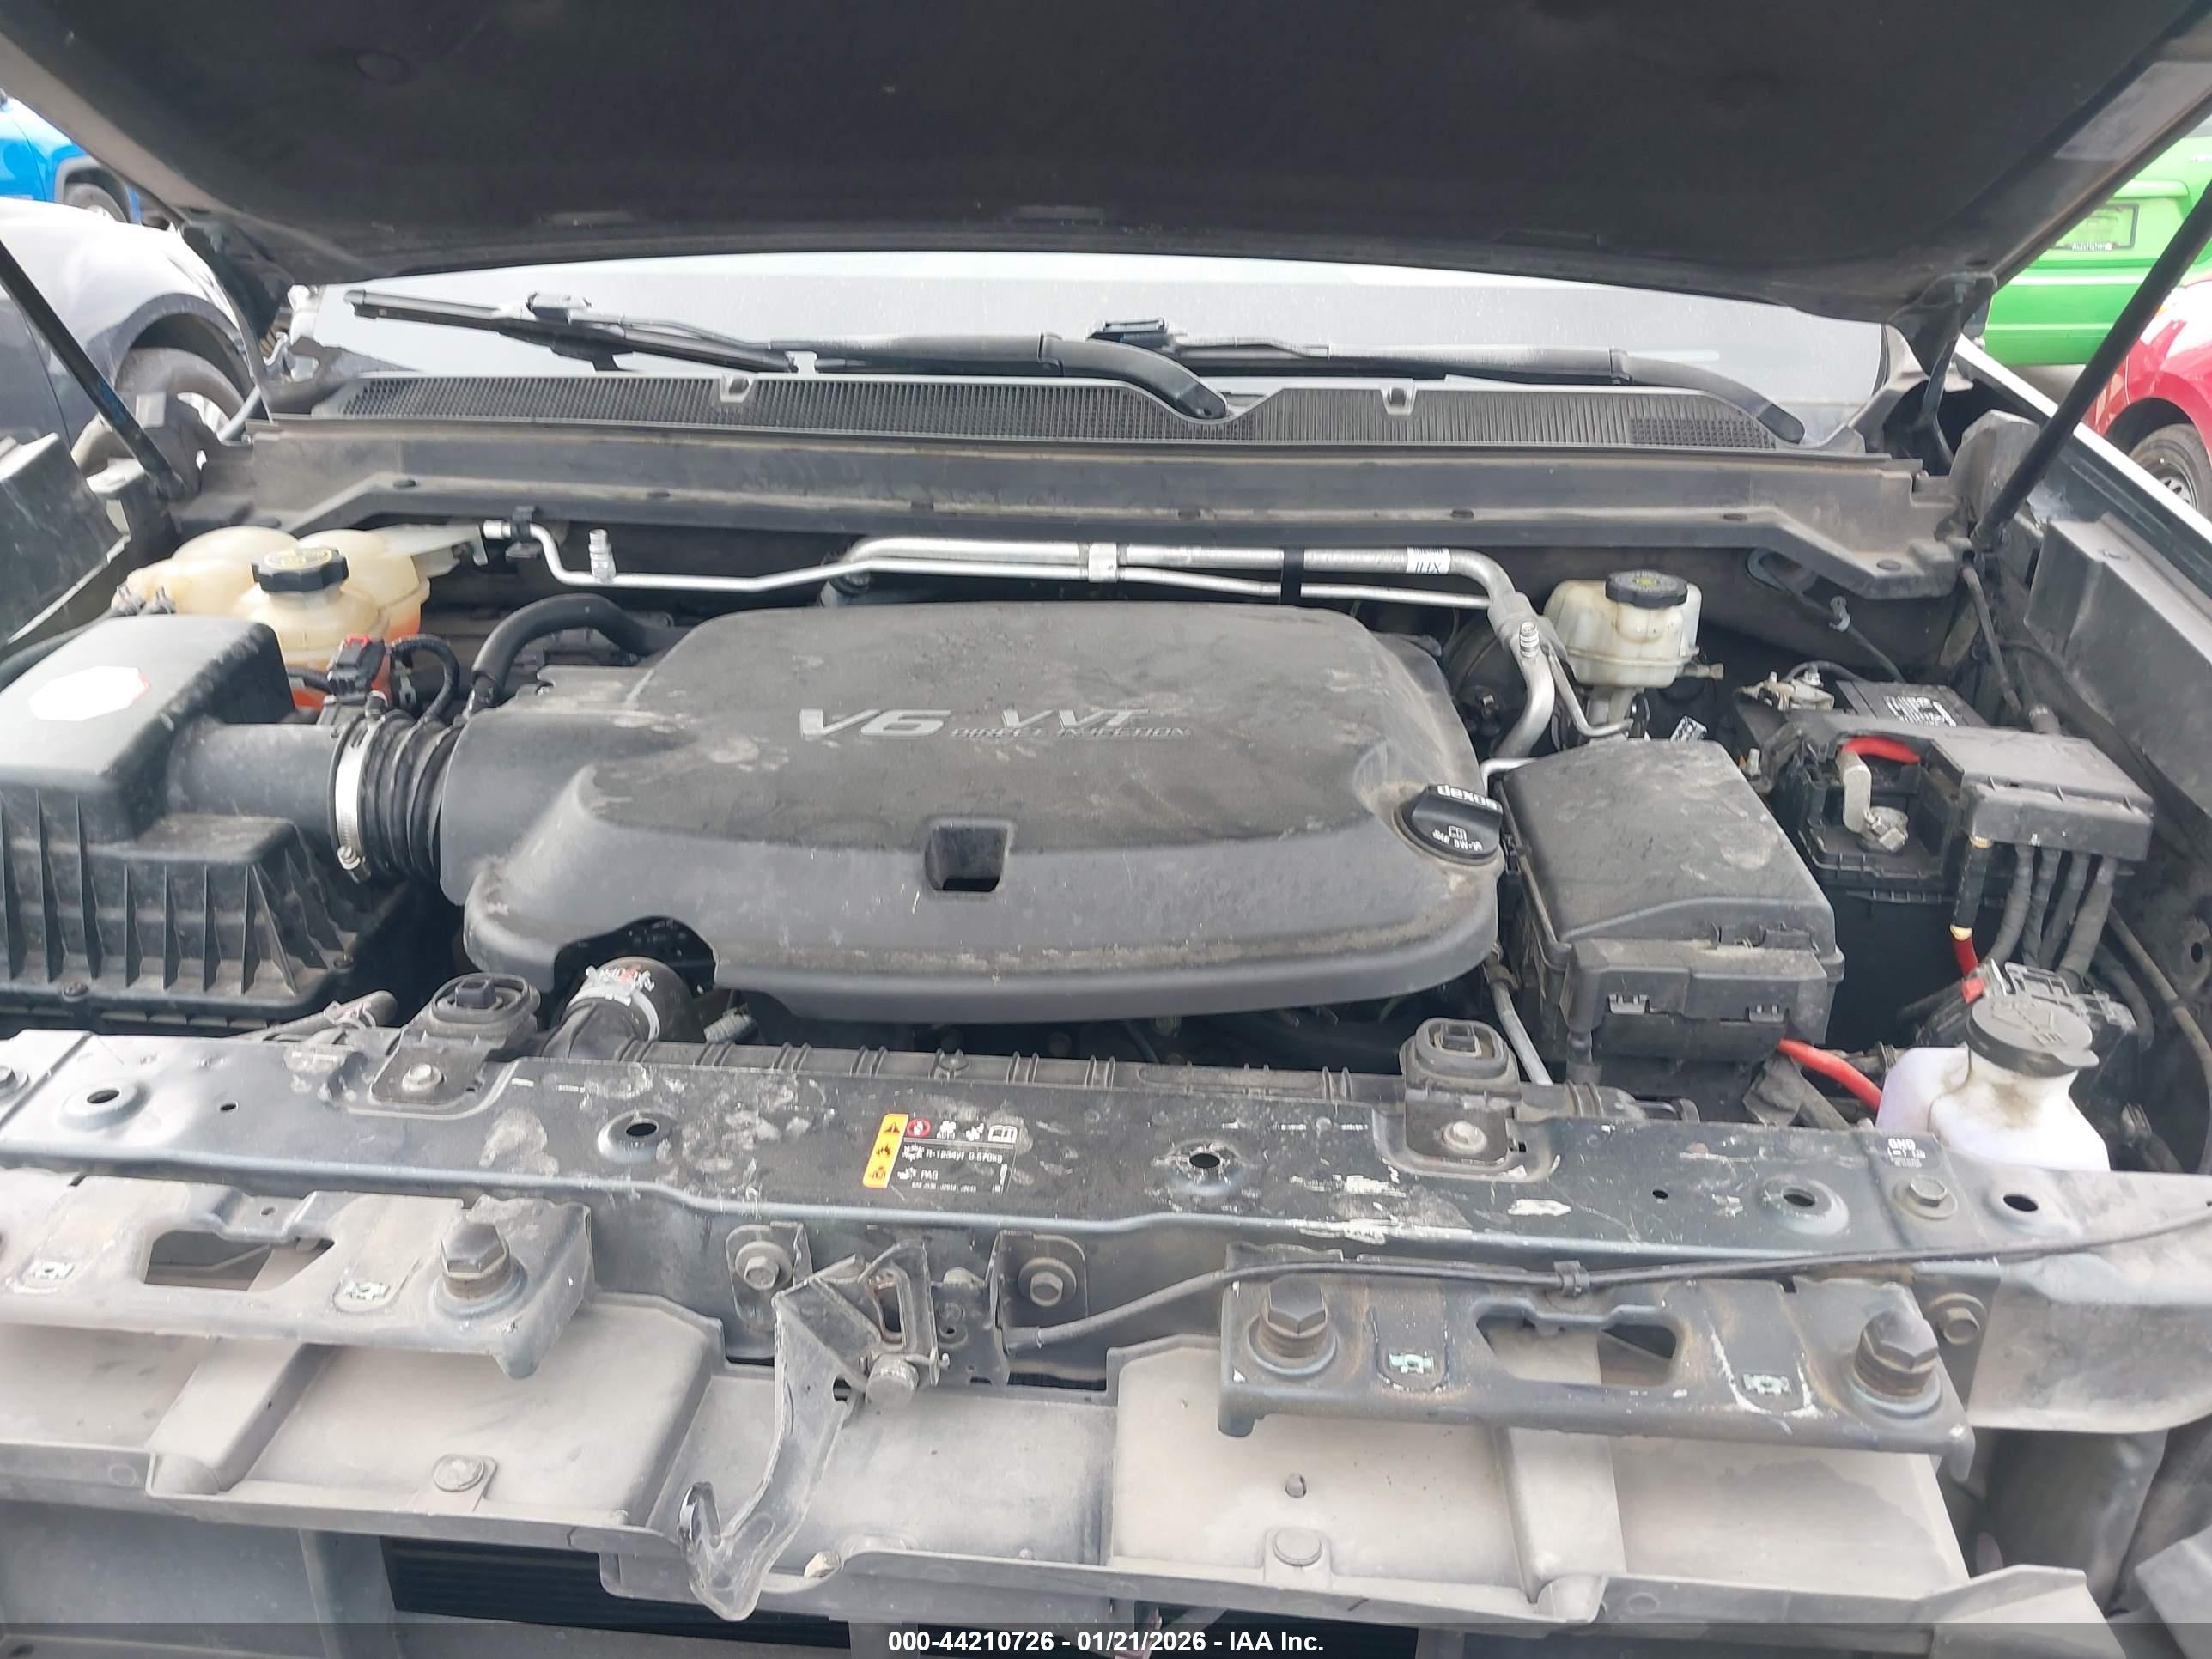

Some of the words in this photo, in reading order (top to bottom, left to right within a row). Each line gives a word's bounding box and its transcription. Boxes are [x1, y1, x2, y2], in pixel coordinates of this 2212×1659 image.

[799, 708, 951, 738] V6
[1002, 708, 1149, 729] VVT
[1057, 727, 1194, 739] INJECTION
[1437, 784, 1498, 811] dexos
[1888, 1138, 1916, 1151] GND
